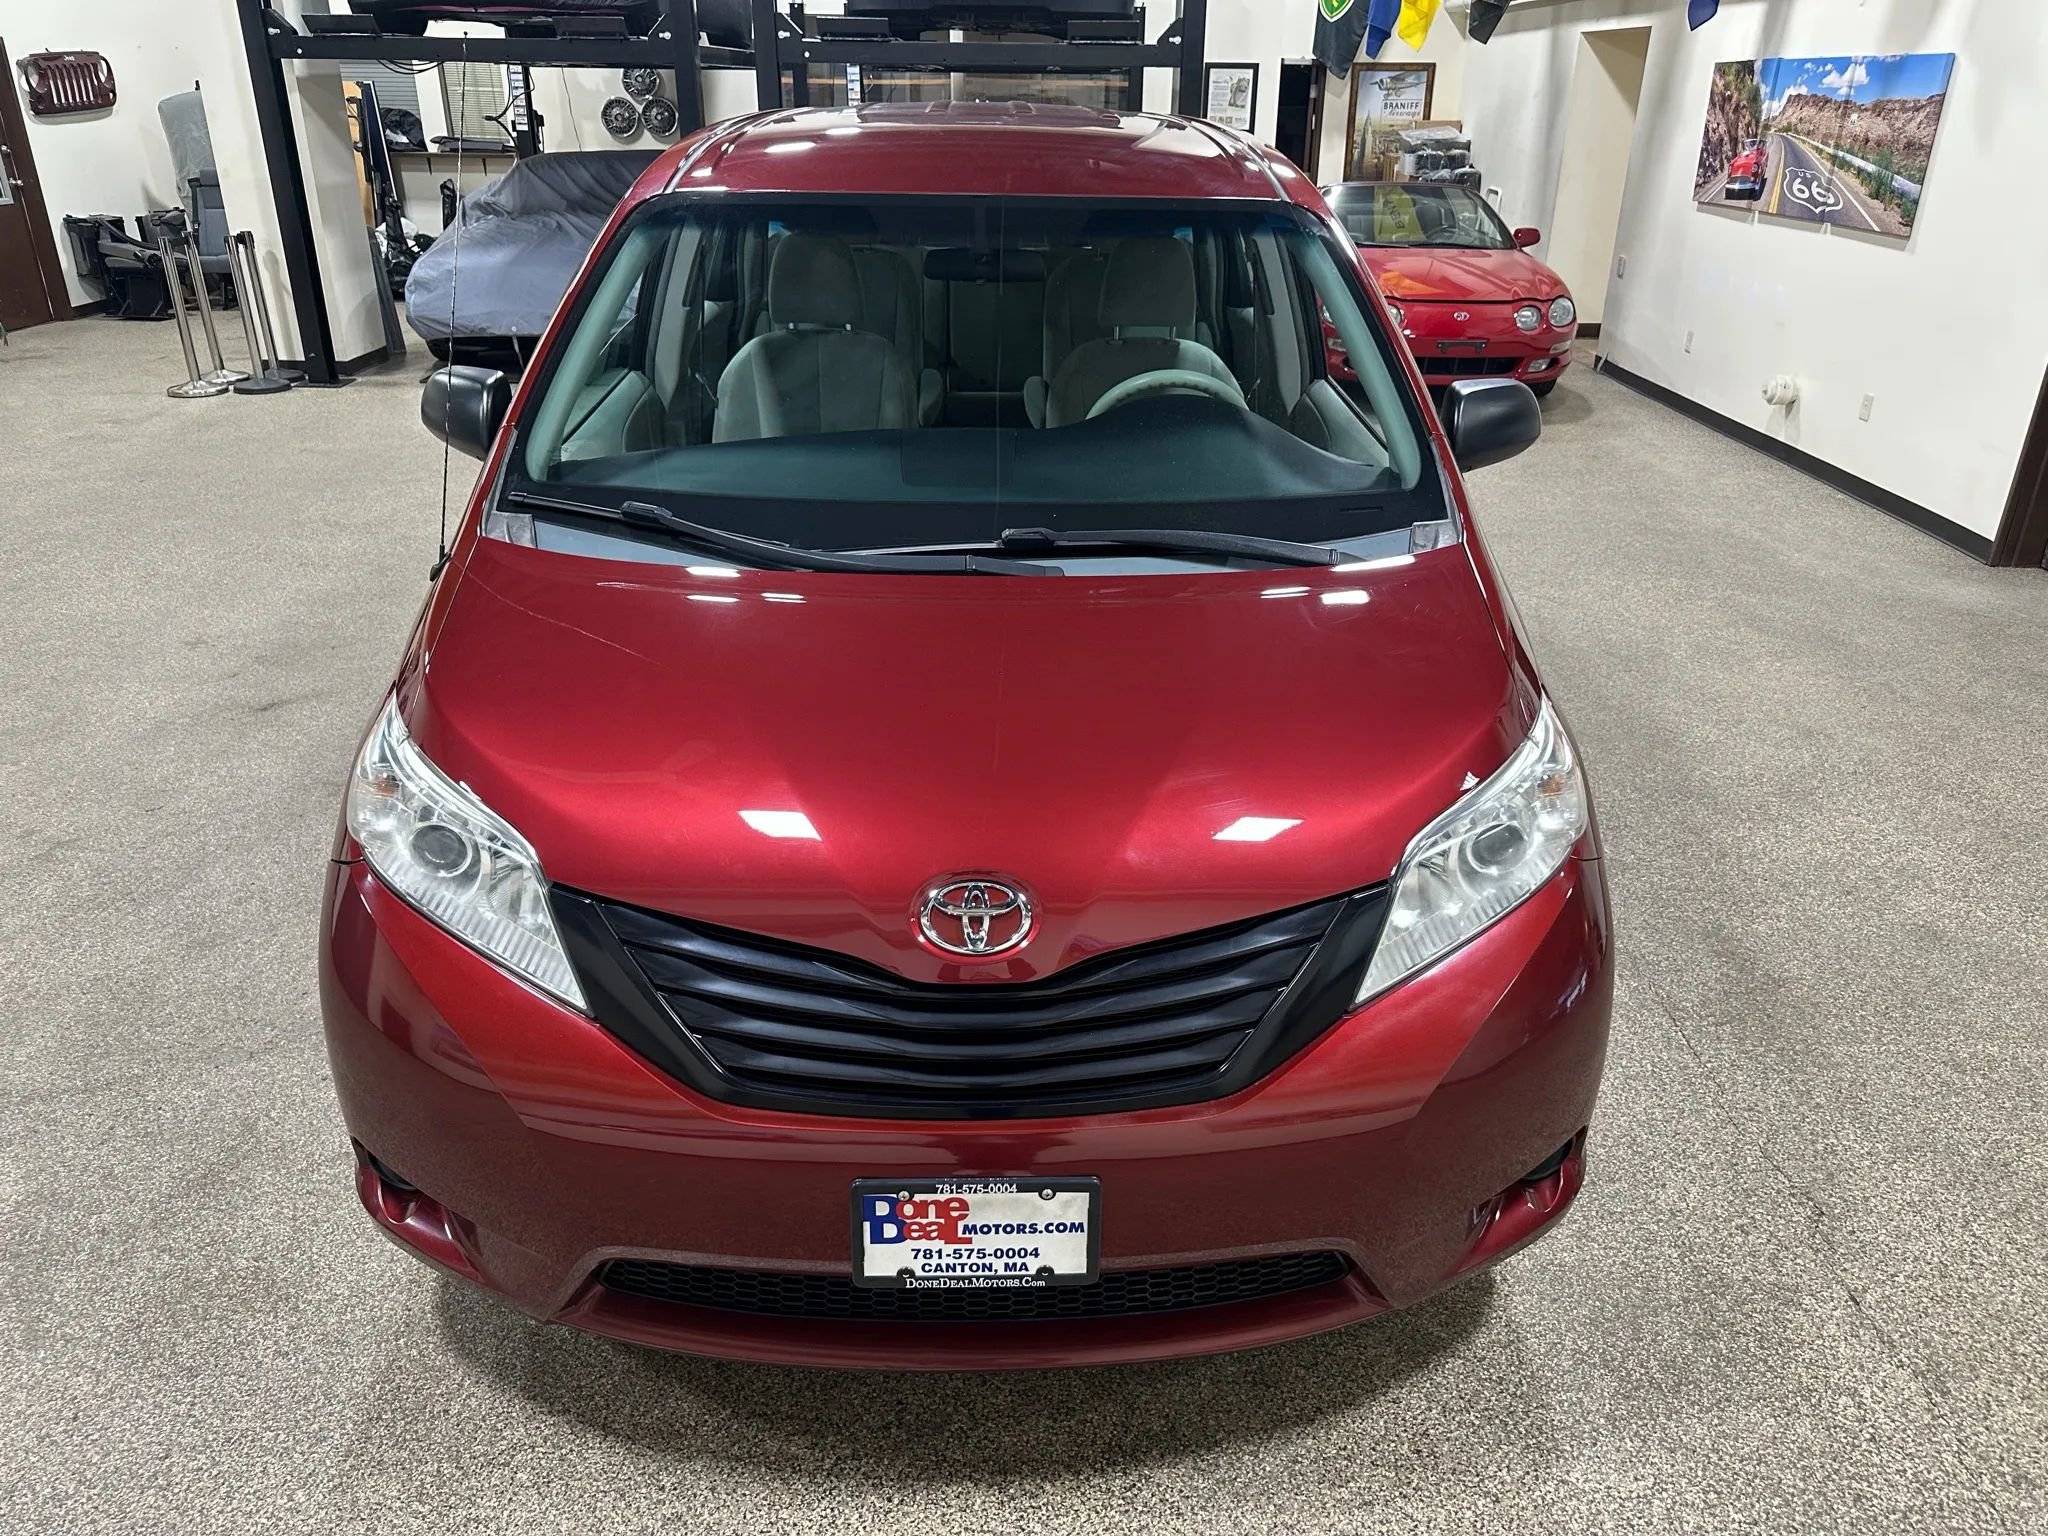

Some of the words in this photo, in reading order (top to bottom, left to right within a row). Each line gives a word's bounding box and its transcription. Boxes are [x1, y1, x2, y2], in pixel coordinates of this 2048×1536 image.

[1384, 102, 1419, 110] BRANIFF
[1792, 177, 1834, 204] 66
[936, 1184, 1017, 1194] 781-575-0004
[863, 1195, 969, 1220] Done
[961, 1222, 1085, 1235] MOTORS.COM
[911, 1247, 1040, 1260] 781-575-0004
[921, 1263, 998, 1274] CANTON,
[1004, 1262, 1029, 1272] MA
